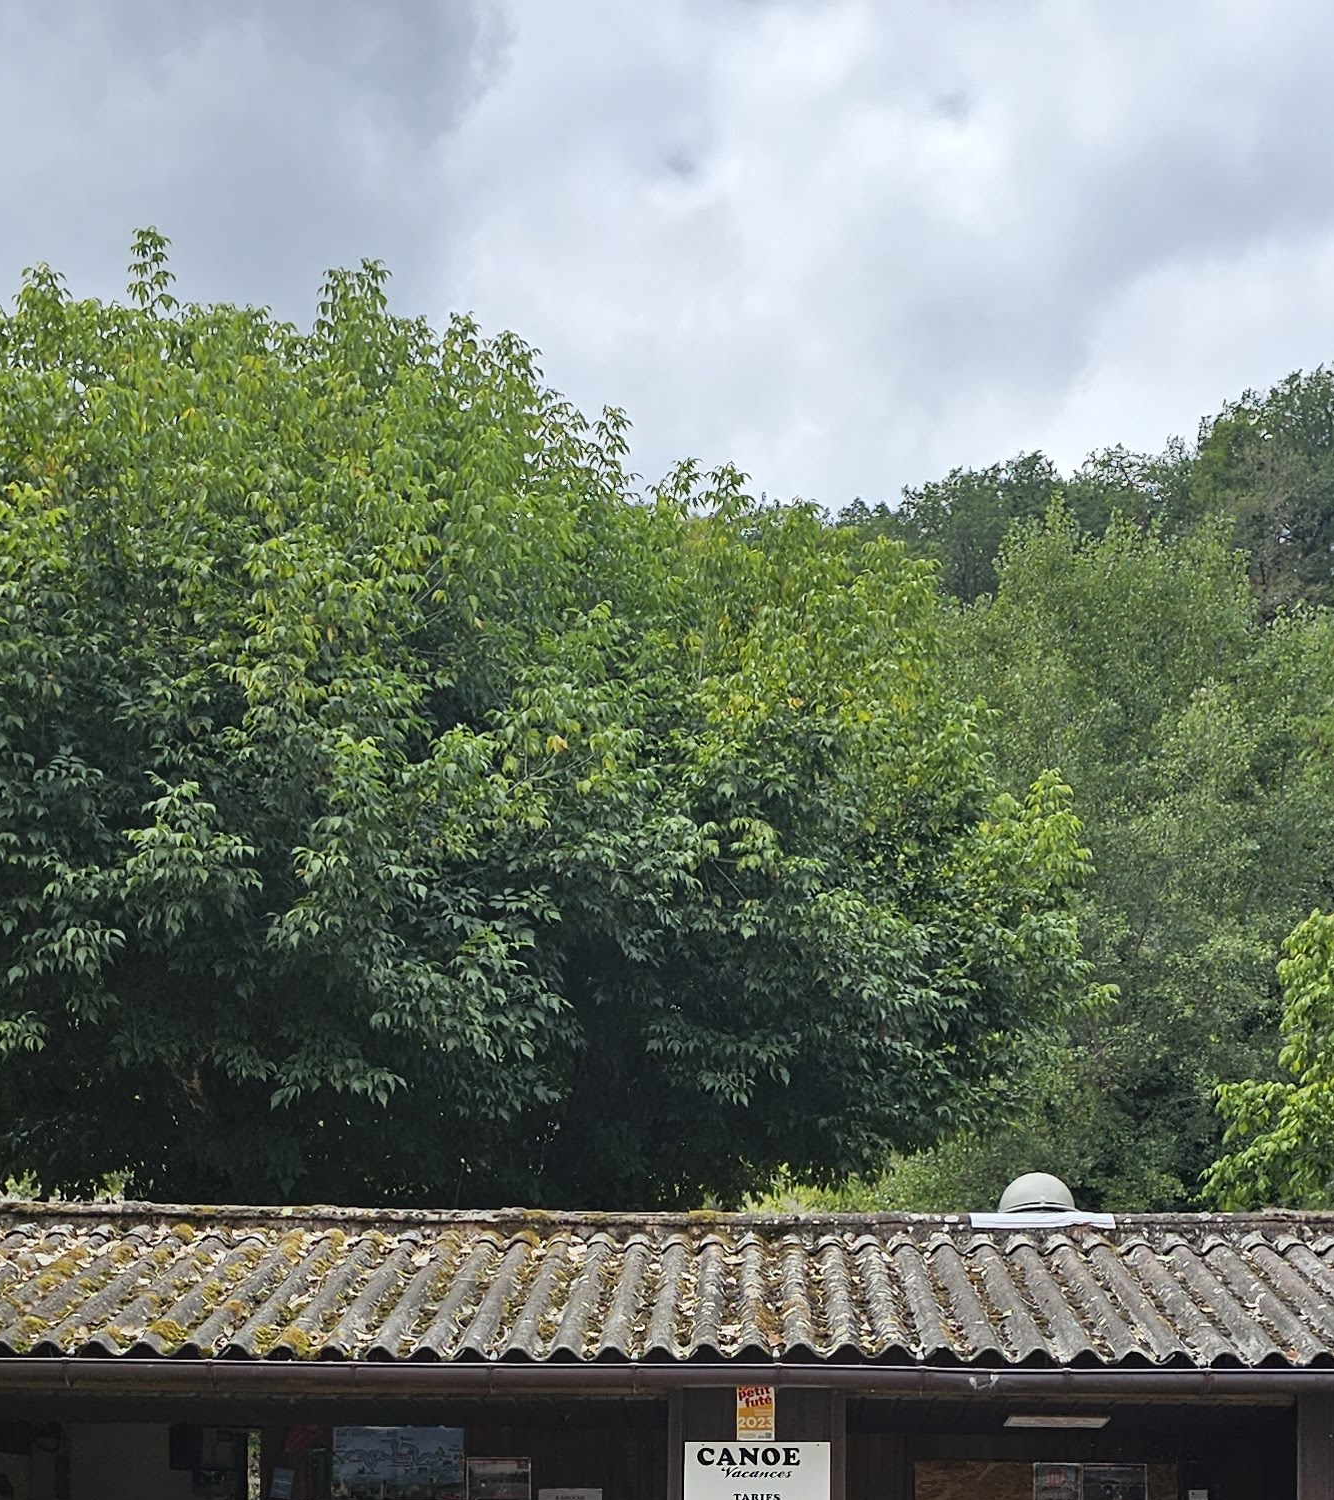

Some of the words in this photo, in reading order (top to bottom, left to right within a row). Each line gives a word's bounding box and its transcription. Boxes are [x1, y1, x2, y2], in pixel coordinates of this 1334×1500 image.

[745, 1395, 772, 1408] futé
[738, 1416, 772, 1429] 2023
[697, 1447, 801, 1466] CANOE
[721, 1466, 792, 1479] Vacances
